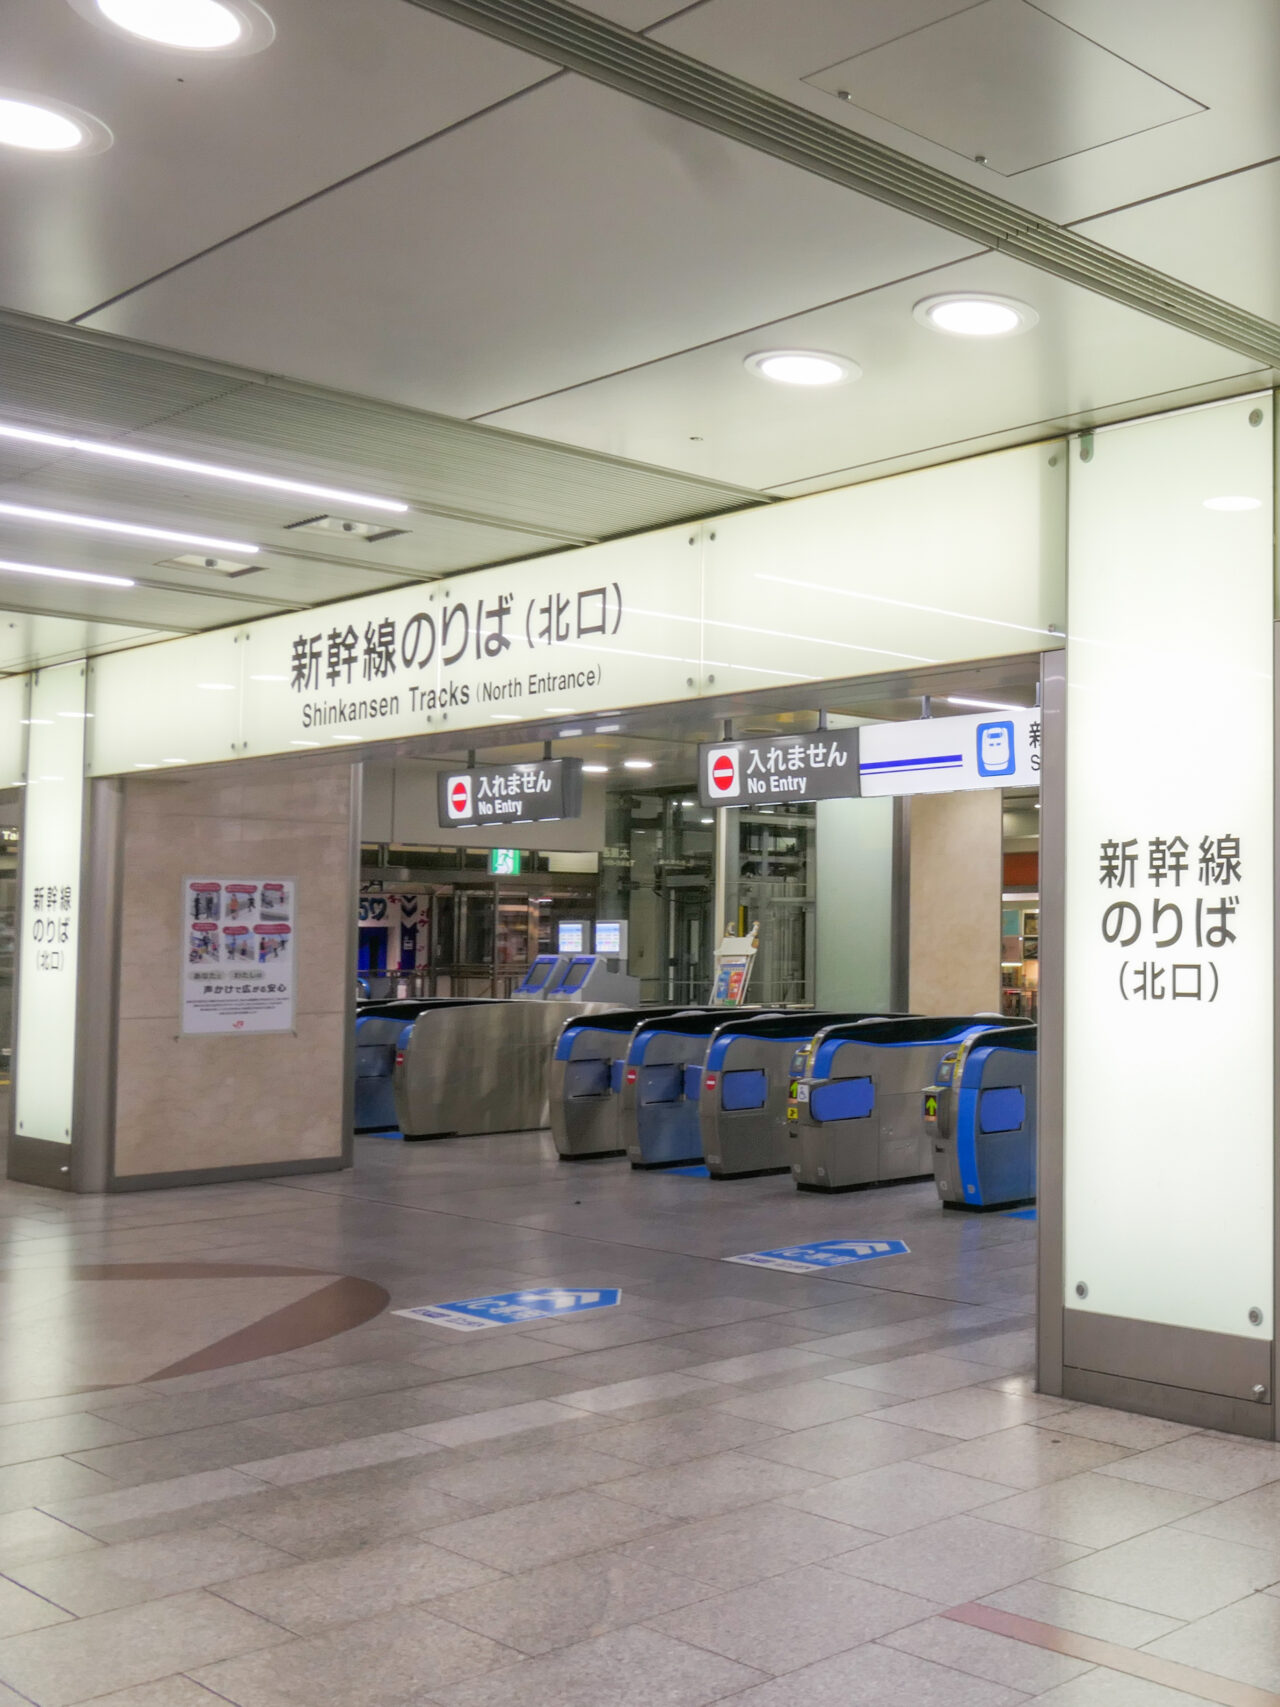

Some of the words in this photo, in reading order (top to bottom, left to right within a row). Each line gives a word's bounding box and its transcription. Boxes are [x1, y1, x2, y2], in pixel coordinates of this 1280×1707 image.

[302, 696, 399, 728] Shinkansen
[409, 681, 470, 712] Tracks
[476, 675, 522, 703] (North
[528, 664, 601, 695] Entrance)
[747, 741, 847, 775] 入れません
[478, 770, 551, 799] 入れません
[748, 778, 767, 794] No
[770, 774, 807, 794] Entry
[478, 801, 493, 815] No
[495, 799, 522, 815] Entry
[1099, 833, 1242, 888] 新幹線
[1101, 895, 1240, 948] のりば
[1119, 961, 1219, 1002] (北口)
